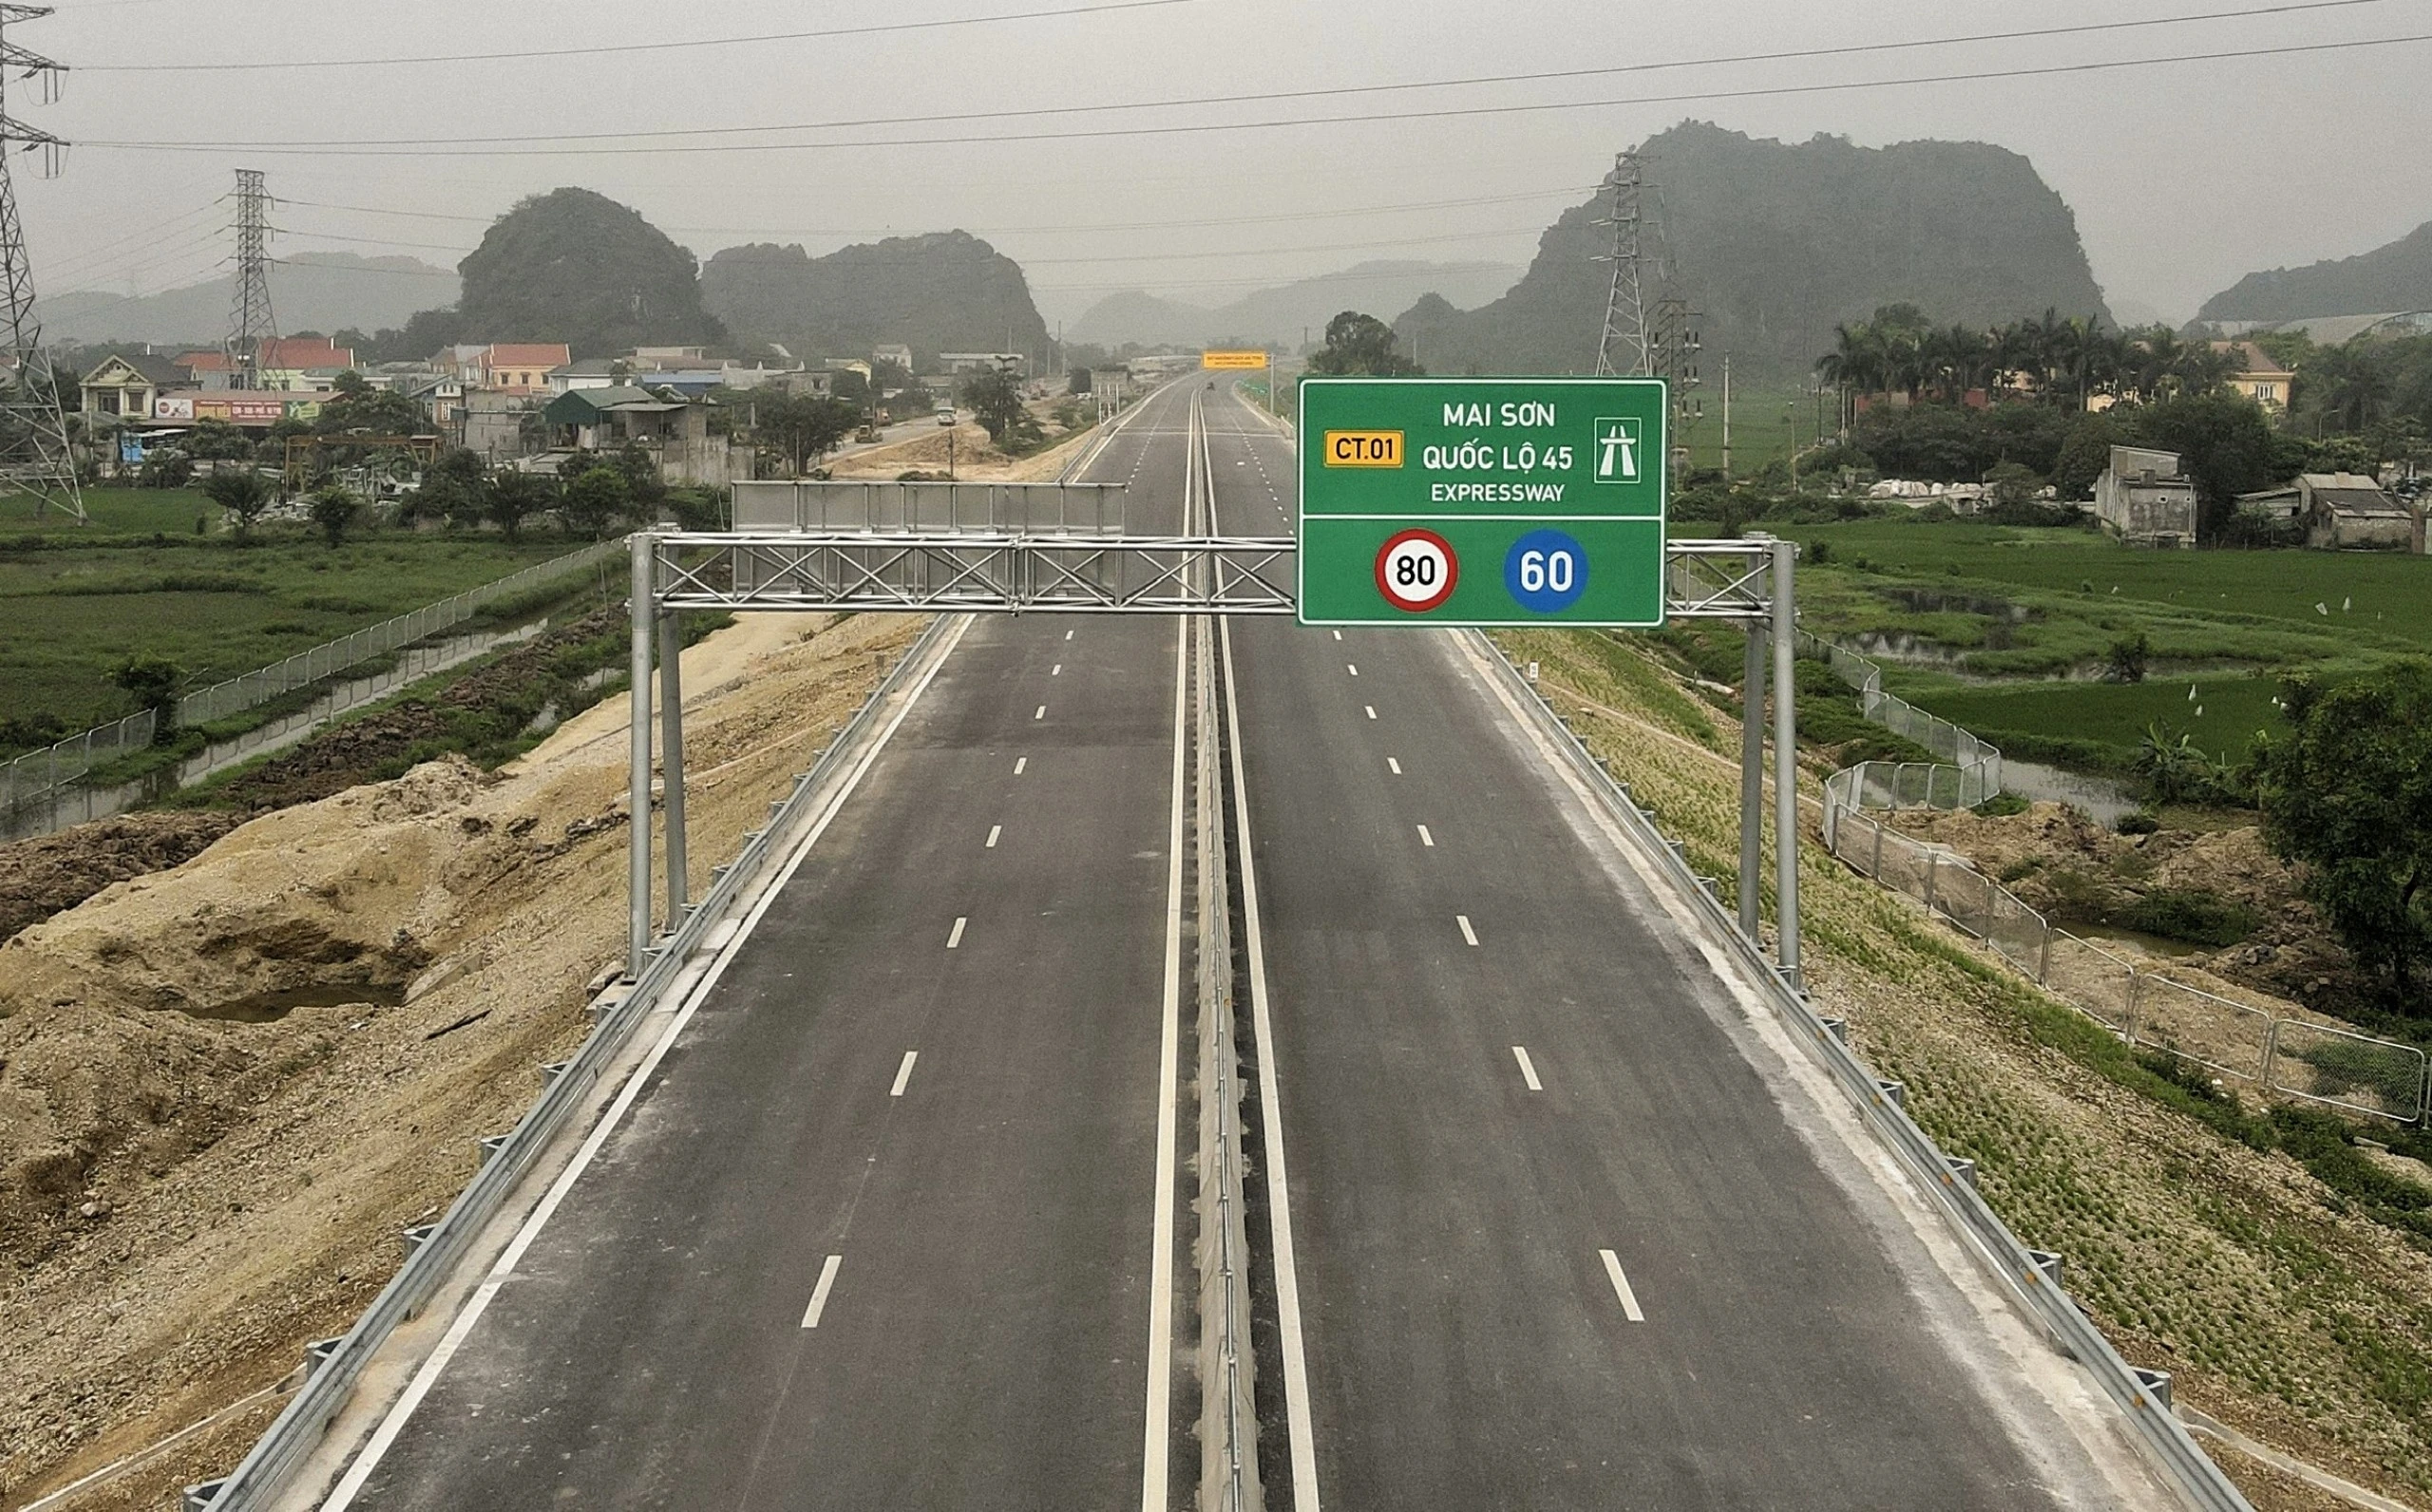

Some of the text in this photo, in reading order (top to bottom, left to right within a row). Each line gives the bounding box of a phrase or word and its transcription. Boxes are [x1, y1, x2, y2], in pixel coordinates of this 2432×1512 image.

[1443, 401, 1555, 426] MAI SƠN
[1336, 438, 1393, 460] CT.01
[1423, 438, 1573, 474] QUỐC LỘ 45
[1432, 484, 1566, 501] EXPRESSWAY
[1396, 556, 1435, 585] 80
[1521, 550, 1573, 592] 60
